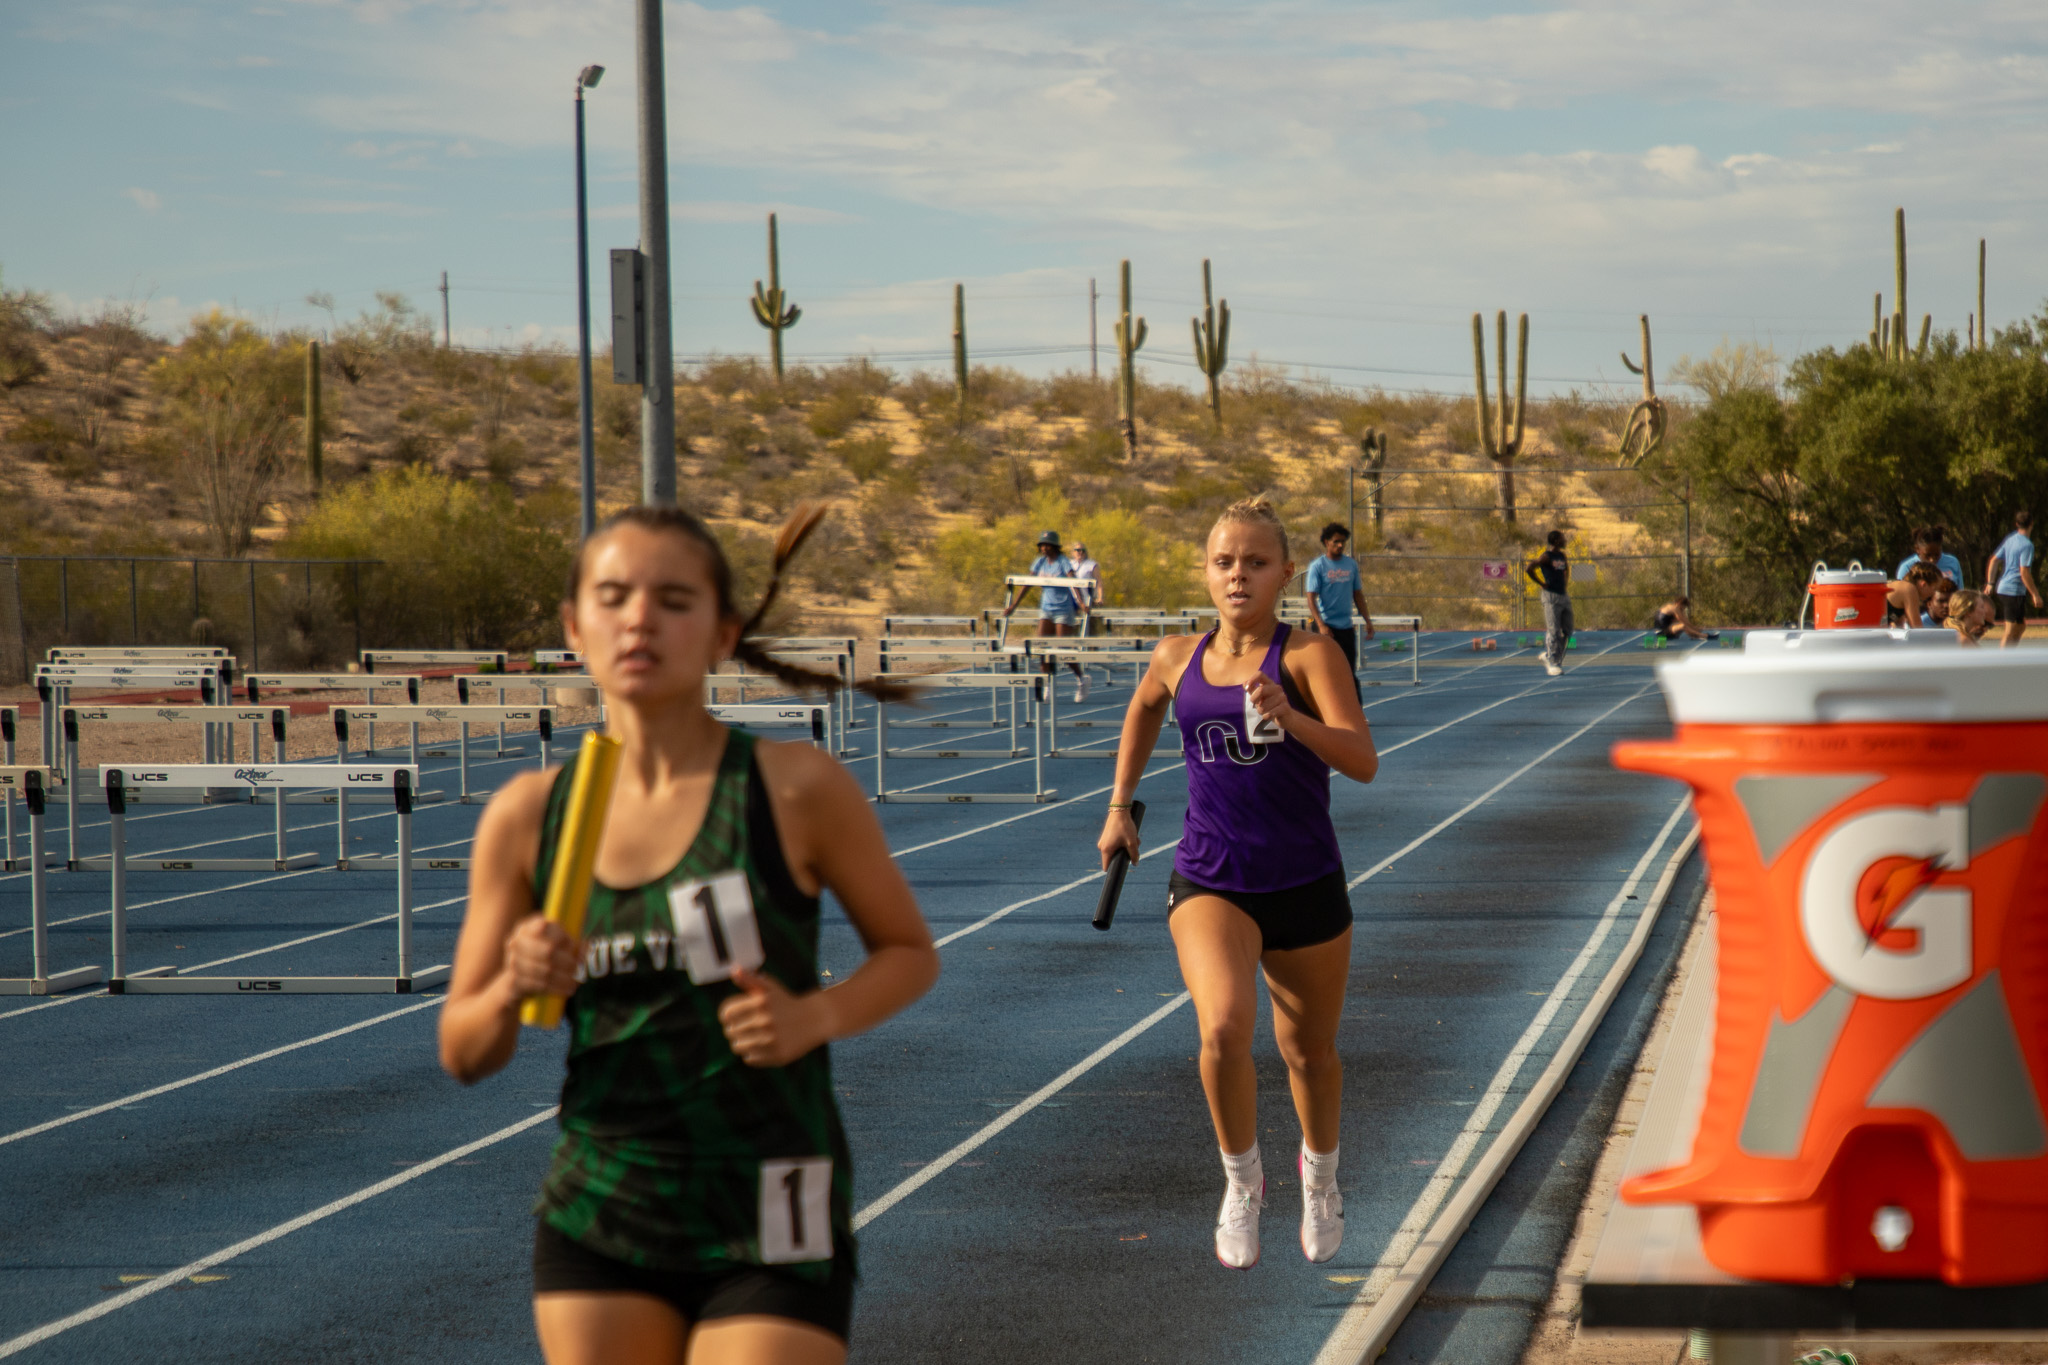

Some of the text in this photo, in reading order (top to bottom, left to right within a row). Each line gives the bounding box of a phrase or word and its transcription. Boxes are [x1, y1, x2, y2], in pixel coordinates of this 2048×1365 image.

[1252, 704, 1279, 736] 2
[692, 886, 730, 964] 1
[1801, 803, 1974, 1000] G
[238, 982, 282, 991] UCS
[573, 932, 638, 984] UE
[780, 1167, 806, 1251] 1
